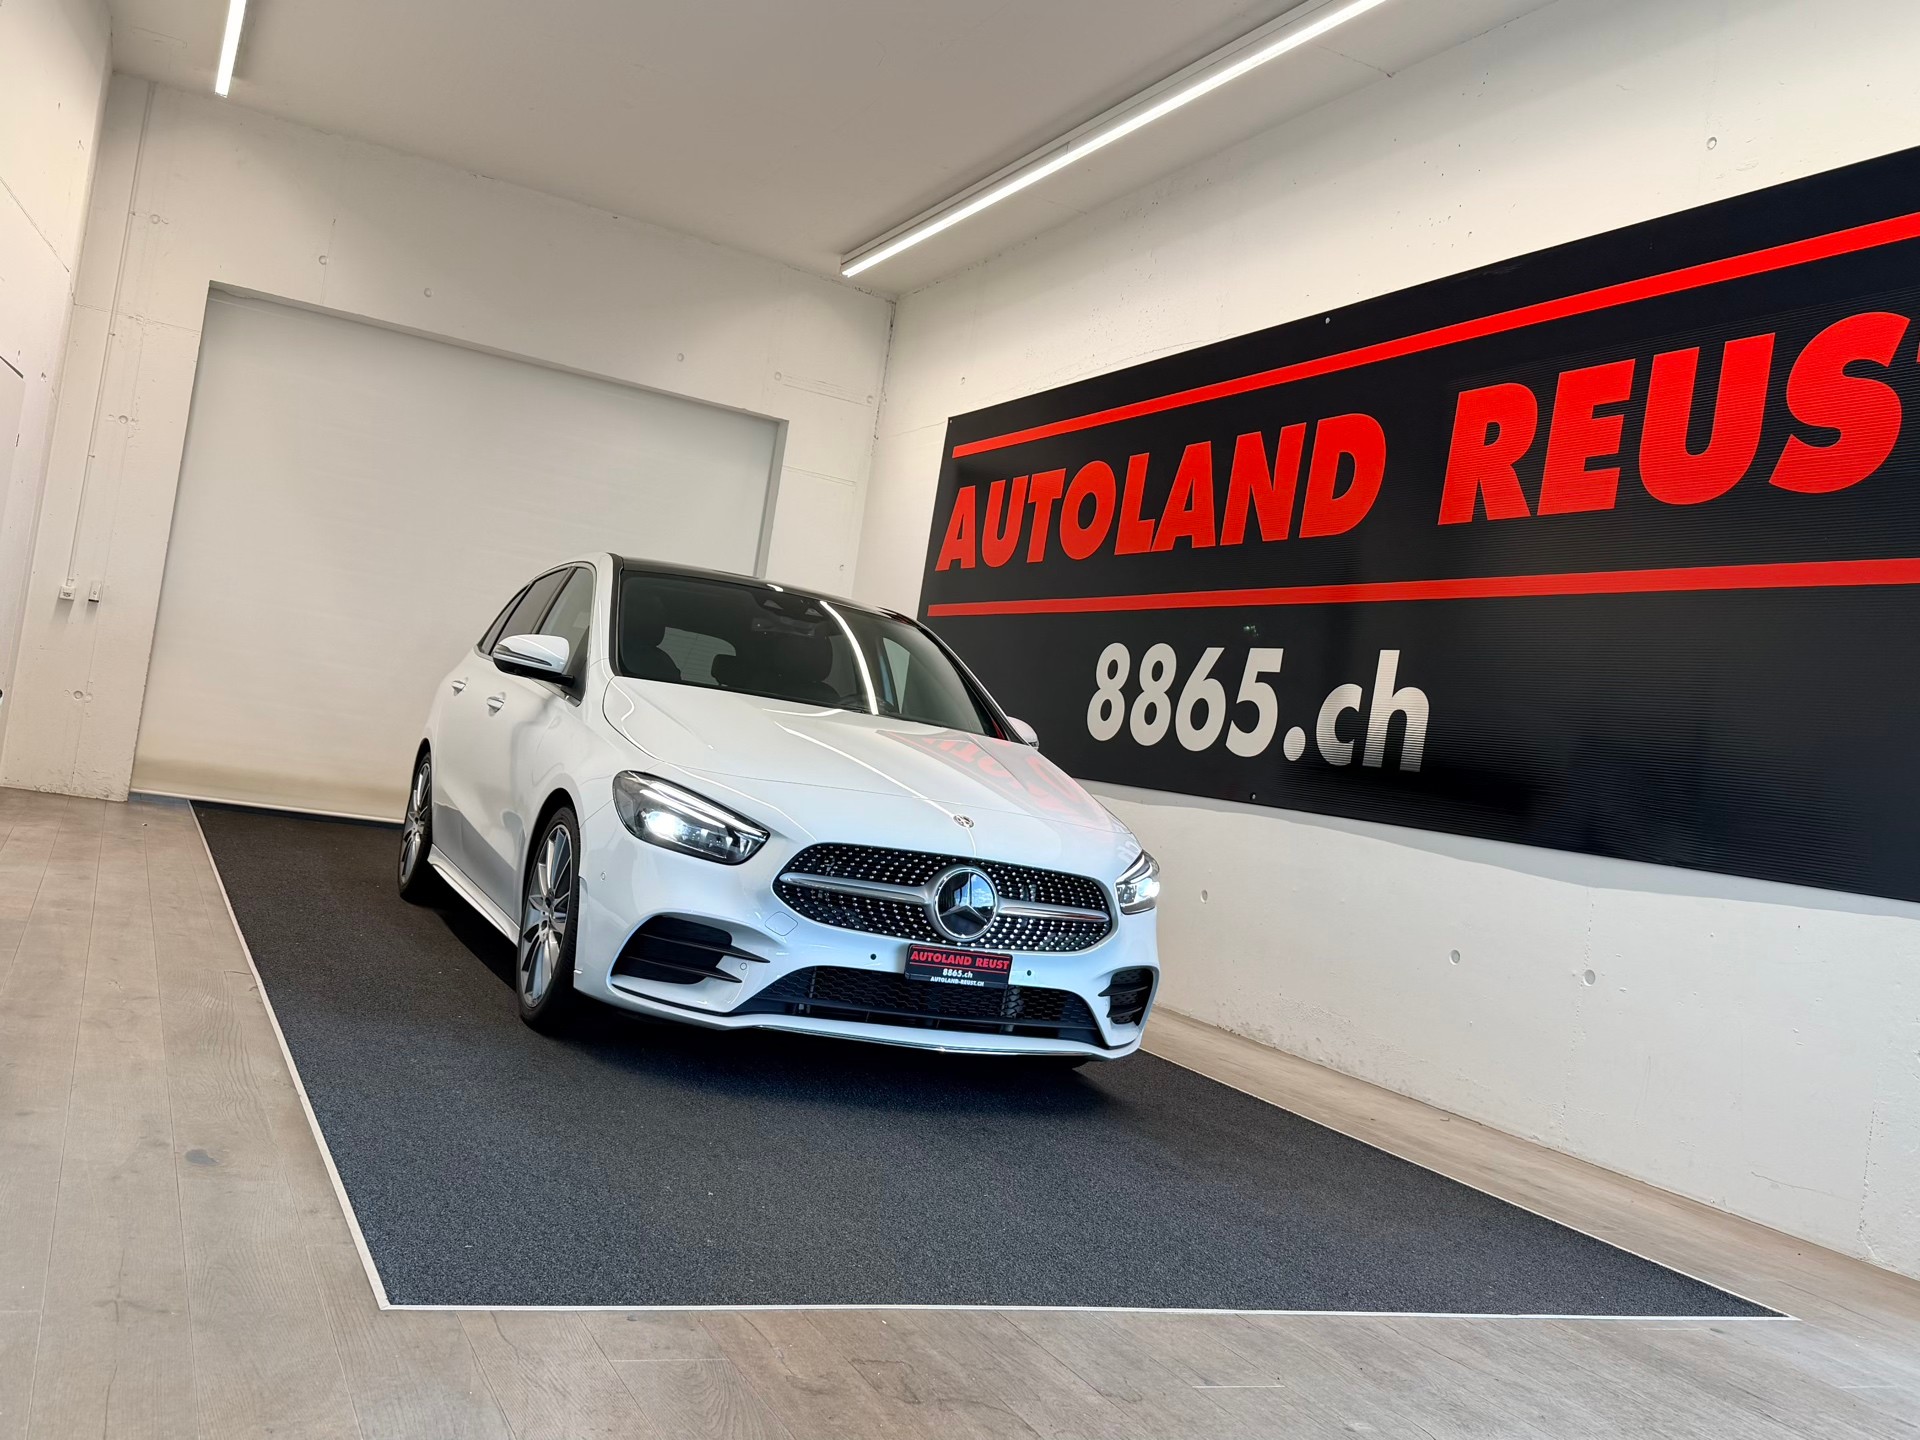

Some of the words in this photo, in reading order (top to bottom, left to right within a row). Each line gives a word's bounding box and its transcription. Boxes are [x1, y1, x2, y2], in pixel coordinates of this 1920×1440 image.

[935, 412, 1388, 572] AUTOLAND
[1438, 311, 1920, 525] REUS
[1086, 642, 1431, 773] 8865.ch
[911, 951, 972, 966] AUTOLAND
[975, 958, 1009, 970] REUST
[930, 976, 984, 987] AUTOLAND-REUST.CH
[942, 968, 973, 979] 8865.ch
